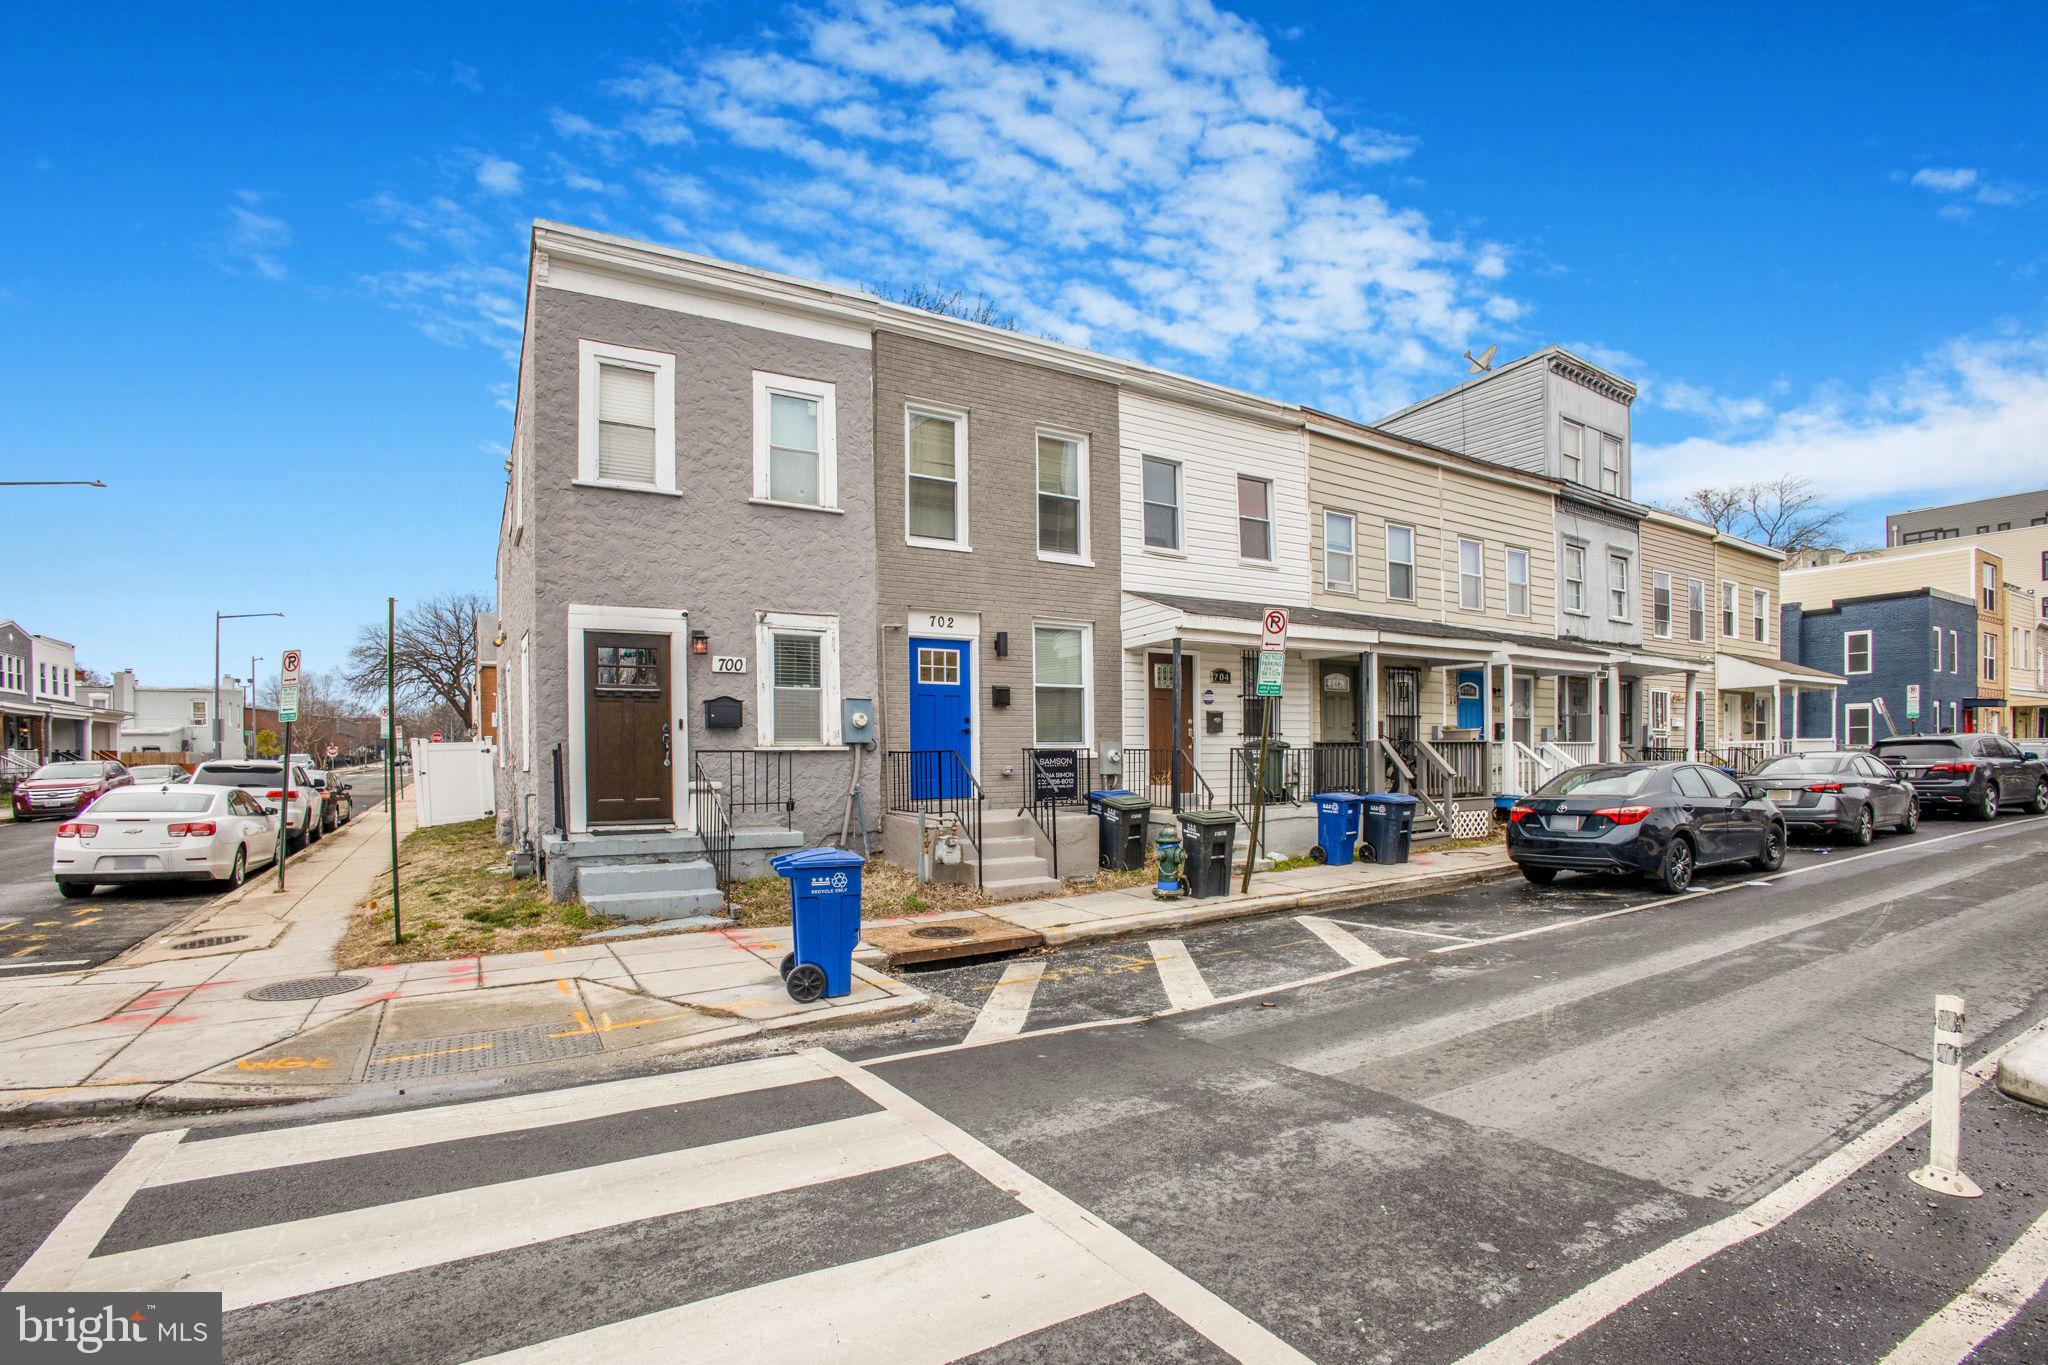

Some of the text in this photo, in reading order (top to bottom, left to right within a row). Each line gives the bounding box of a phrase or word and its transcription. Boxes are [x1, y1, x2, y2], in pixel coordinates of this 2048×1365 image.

[930, 615, 954, 628] 702
[718, 658, 744, 672] 700
[1213, 673, 1229, 681] 704
